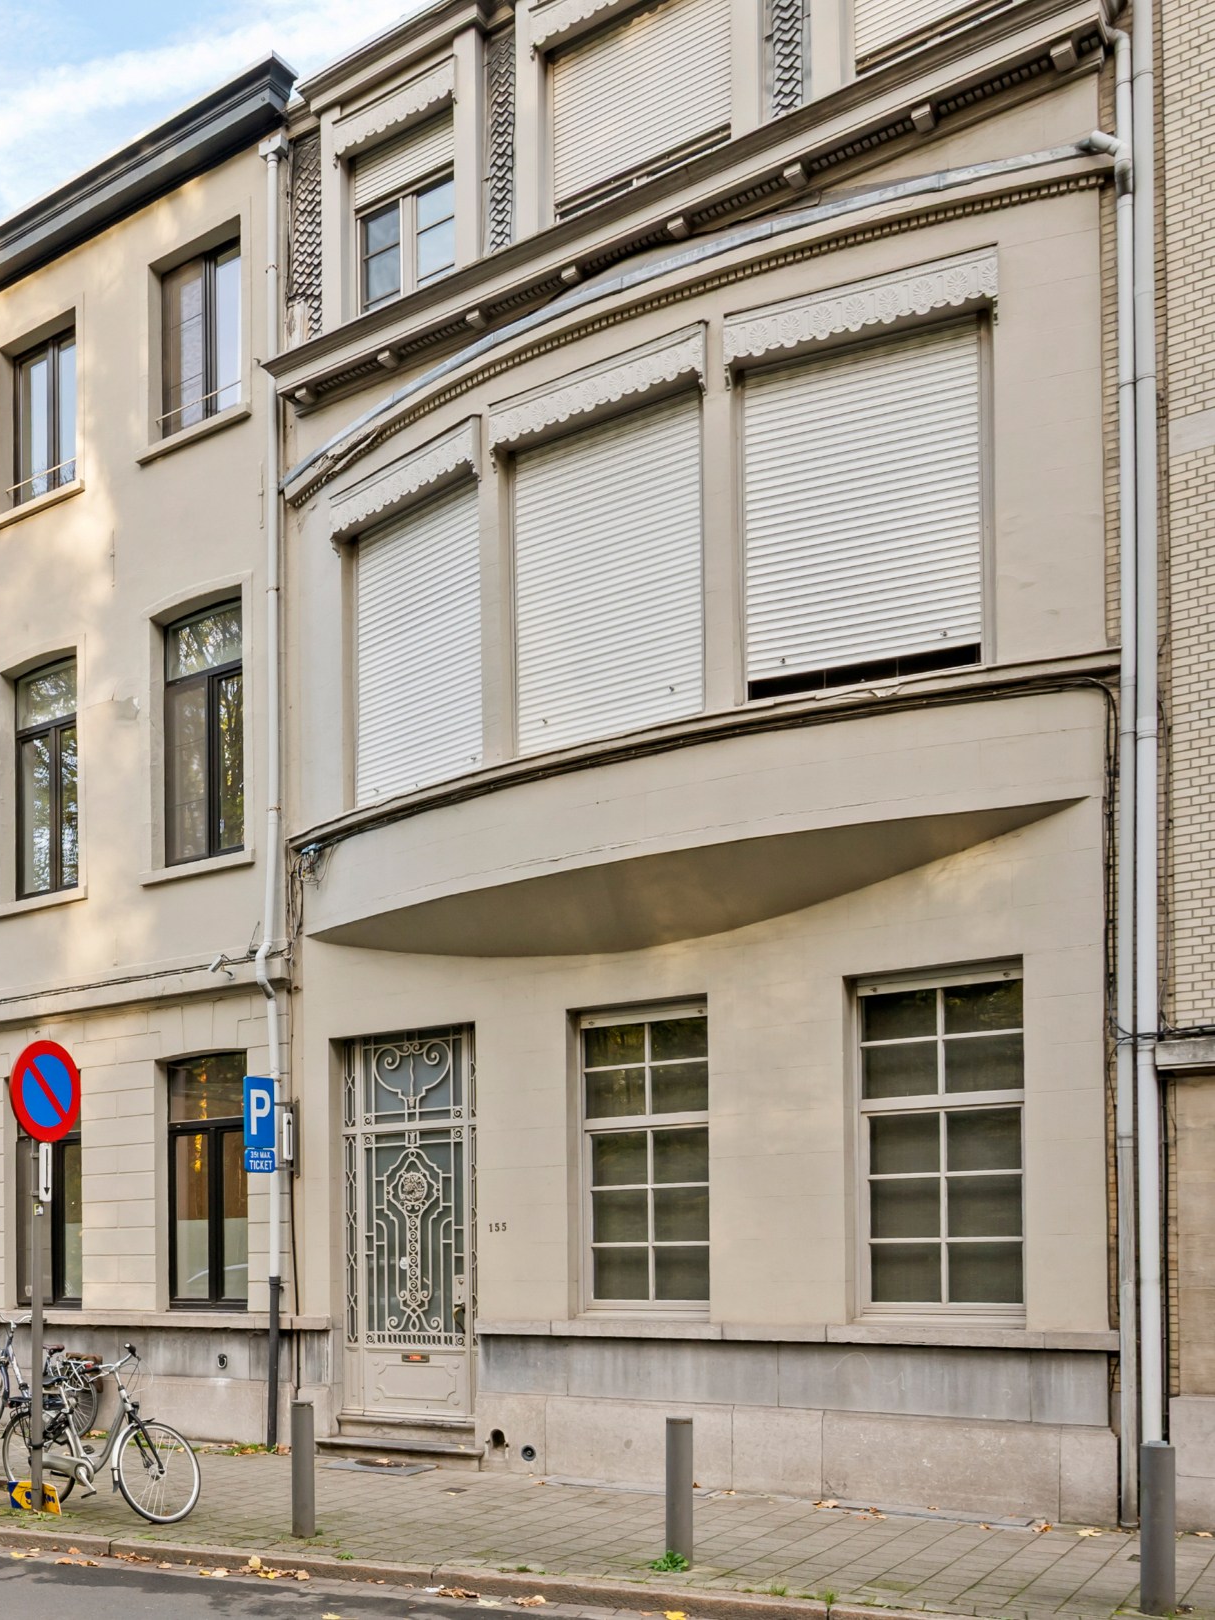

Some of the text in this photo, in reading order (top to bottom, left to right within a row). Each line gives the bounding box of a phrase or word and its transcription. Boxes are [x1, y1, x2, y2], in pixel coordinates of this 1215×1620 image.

[250, 1088, 271, 1135] P
[249, 1159, 273, 1170] TICKET
[489, 1222, 506, 1232] 155
